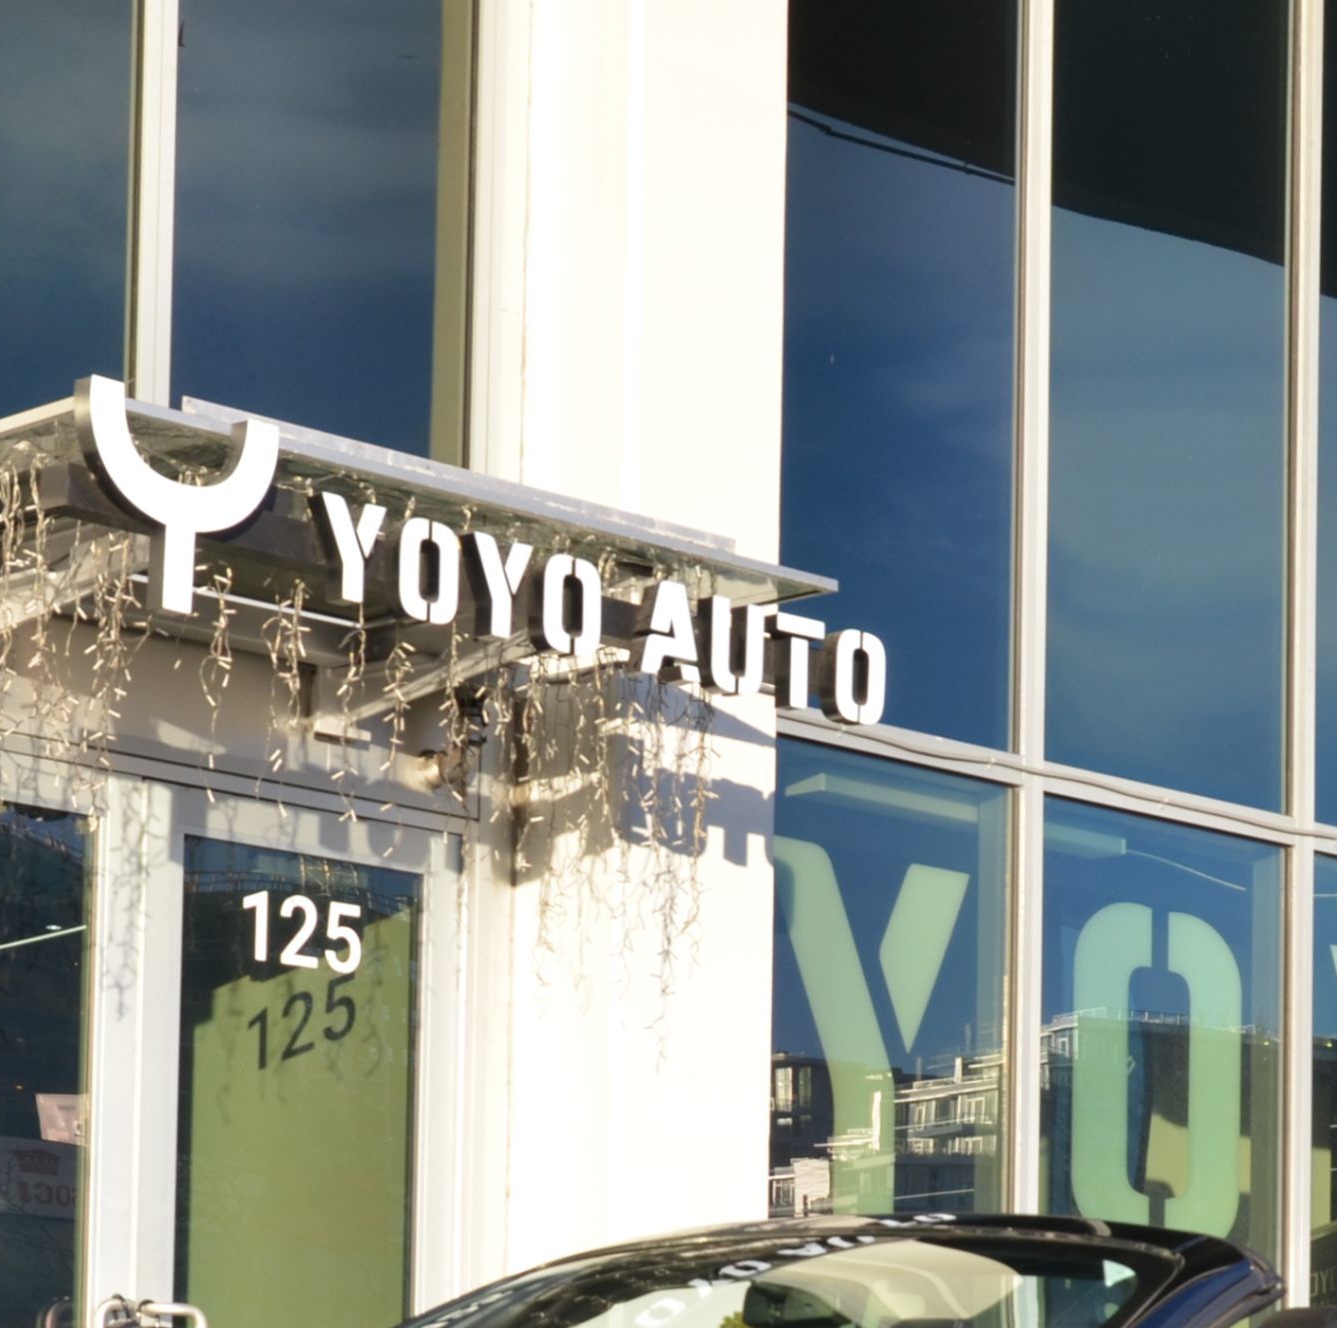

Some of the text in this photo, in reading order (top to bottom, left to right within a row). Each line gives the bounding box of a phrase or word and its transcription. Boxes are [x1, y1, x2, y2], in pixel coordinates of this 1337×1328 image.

[321, 492, 887, 726] YOYO AUTO
[243, 890, 363, 974] 125
